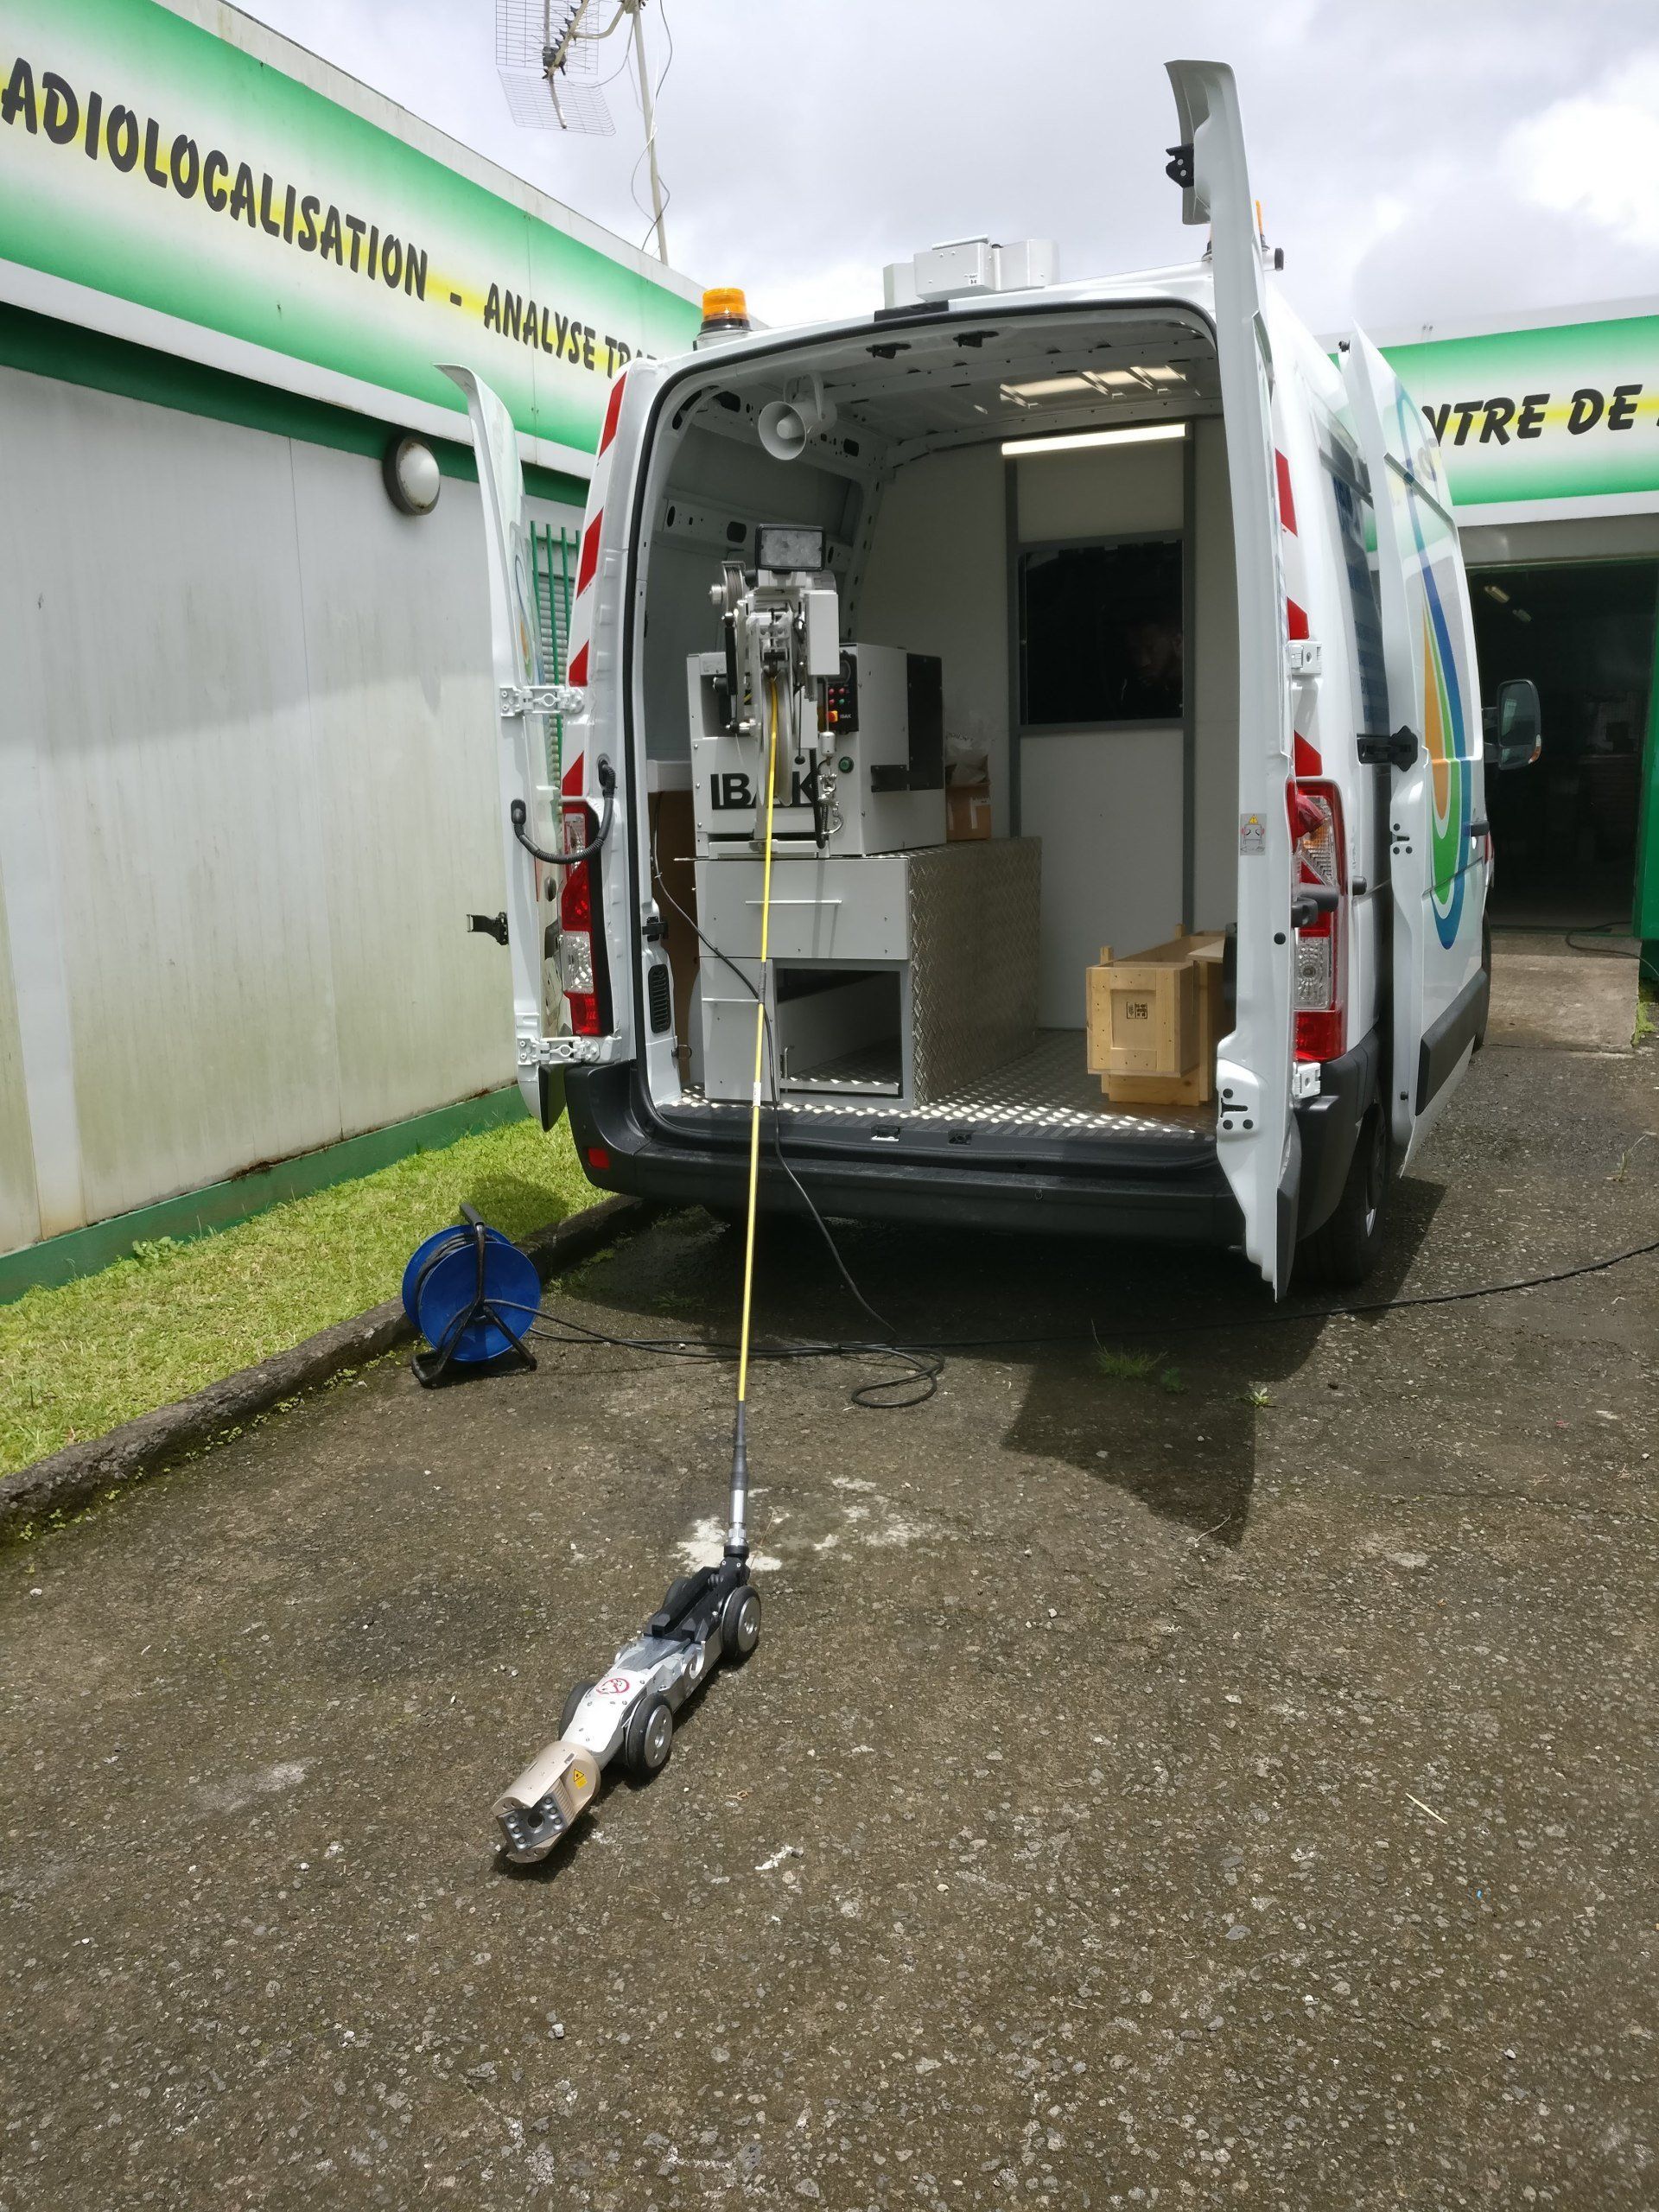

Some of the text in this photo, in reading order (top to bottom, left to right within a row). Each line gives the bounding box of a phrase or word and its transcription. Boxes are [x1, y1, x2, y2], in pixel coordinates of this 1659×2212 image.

[1, 57, 428, 301] ADIOLOCALISATION
[484, 283, 595, 371] ANALYSE
[1567, 385, 1643, 435] DE
[710, 772, 817, 810] IBK
